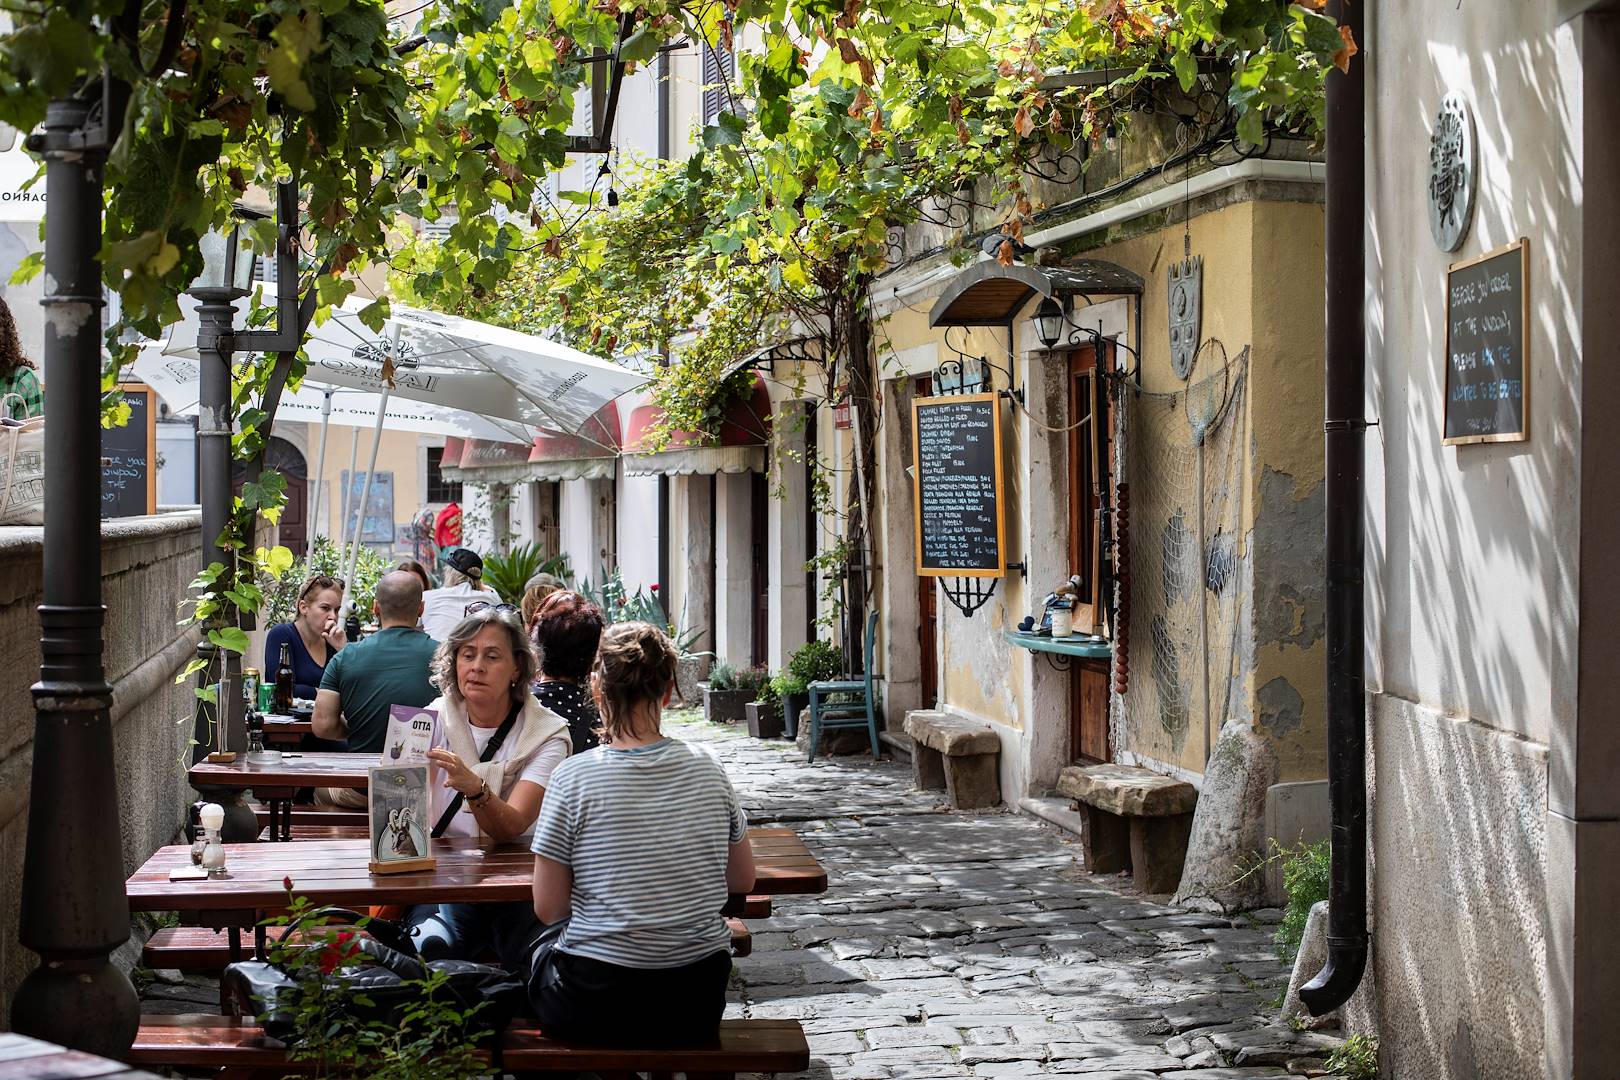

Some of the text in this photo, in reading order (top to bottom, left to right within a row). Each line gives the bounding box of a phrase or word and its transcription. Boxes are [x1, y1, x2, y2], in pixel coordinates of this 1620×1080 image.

[1452, 282, 1475, 307] BEFORE
[1490, 272, 1512, 293] ORDER
[1453, 321, 1462, 337] AT
[1465, 316, 1477, 336] THE
[1453, 353, 1477, 371] PLEASE
[108, 480, 126, 488] THE
[412, 720, 431, 731] OTTA
